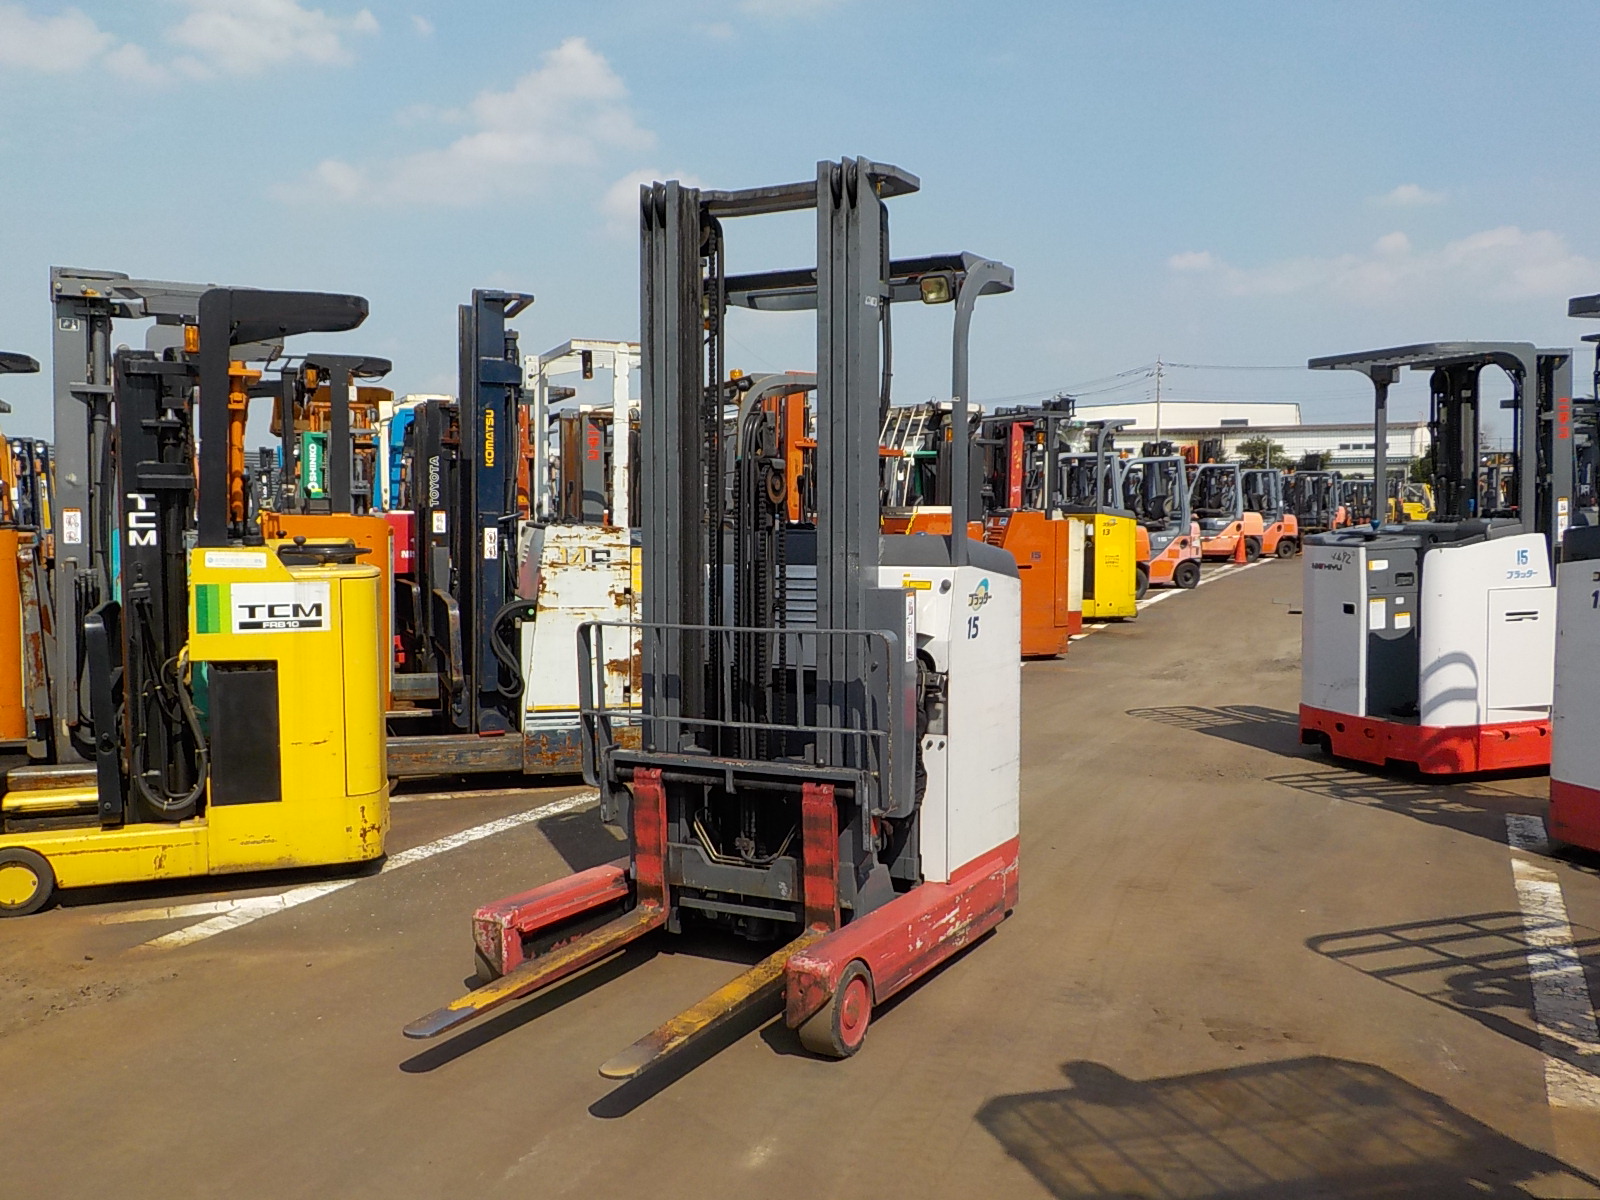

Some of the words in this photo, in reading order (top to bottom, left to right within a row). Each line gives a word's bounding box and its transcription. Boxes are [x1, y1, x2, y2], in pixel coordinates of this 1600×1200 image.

[485, 409, 494, 467] KOMATSU
[429, 455, 440, 508] TOYOTA
[127, 493, 157, 547] TCM
[1517, 549, 1528, 566] 15
[238, 603, 322, 619] TCM
[262, 620, 300, 629] FRB10
[968, 616, 980, 640] 15
